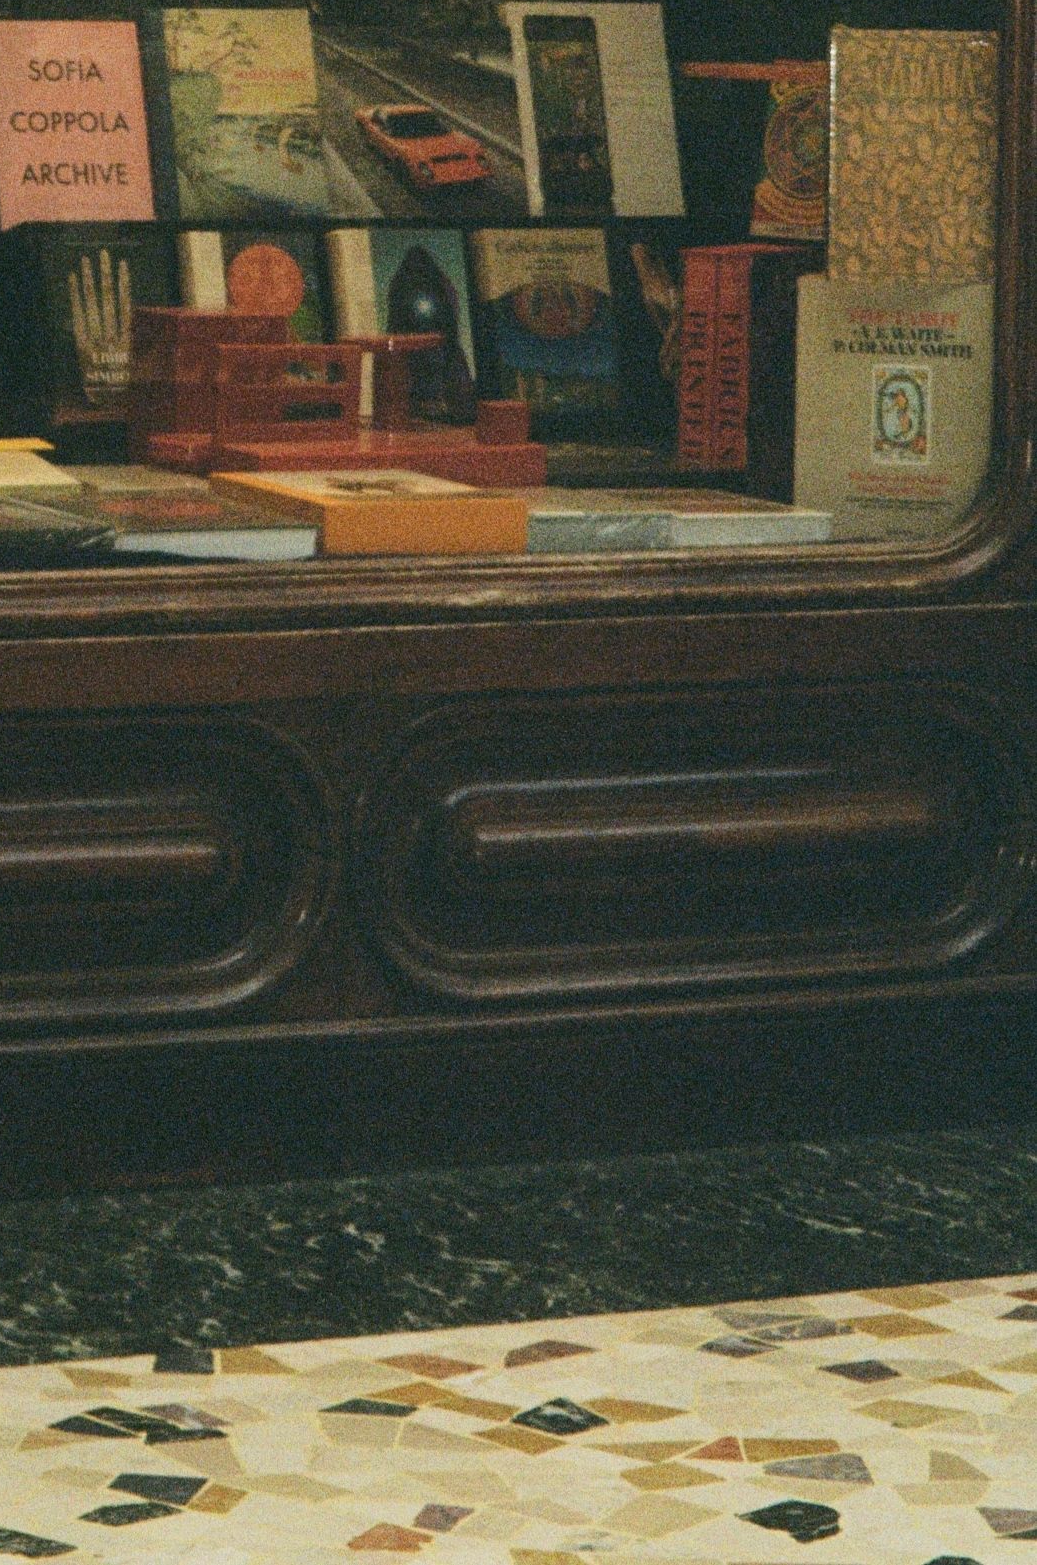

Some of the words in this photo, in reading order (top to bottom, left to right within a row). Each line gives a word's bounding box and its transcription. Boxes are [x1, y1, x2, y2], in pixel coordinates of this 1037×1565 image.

[27, 60, 102, 82] SOFIA
[10, 110, 130, 134] COPPOLA
[21, 162, 129, 187] ARCHIVE
[719, 312, 741, 462] FABRICS
